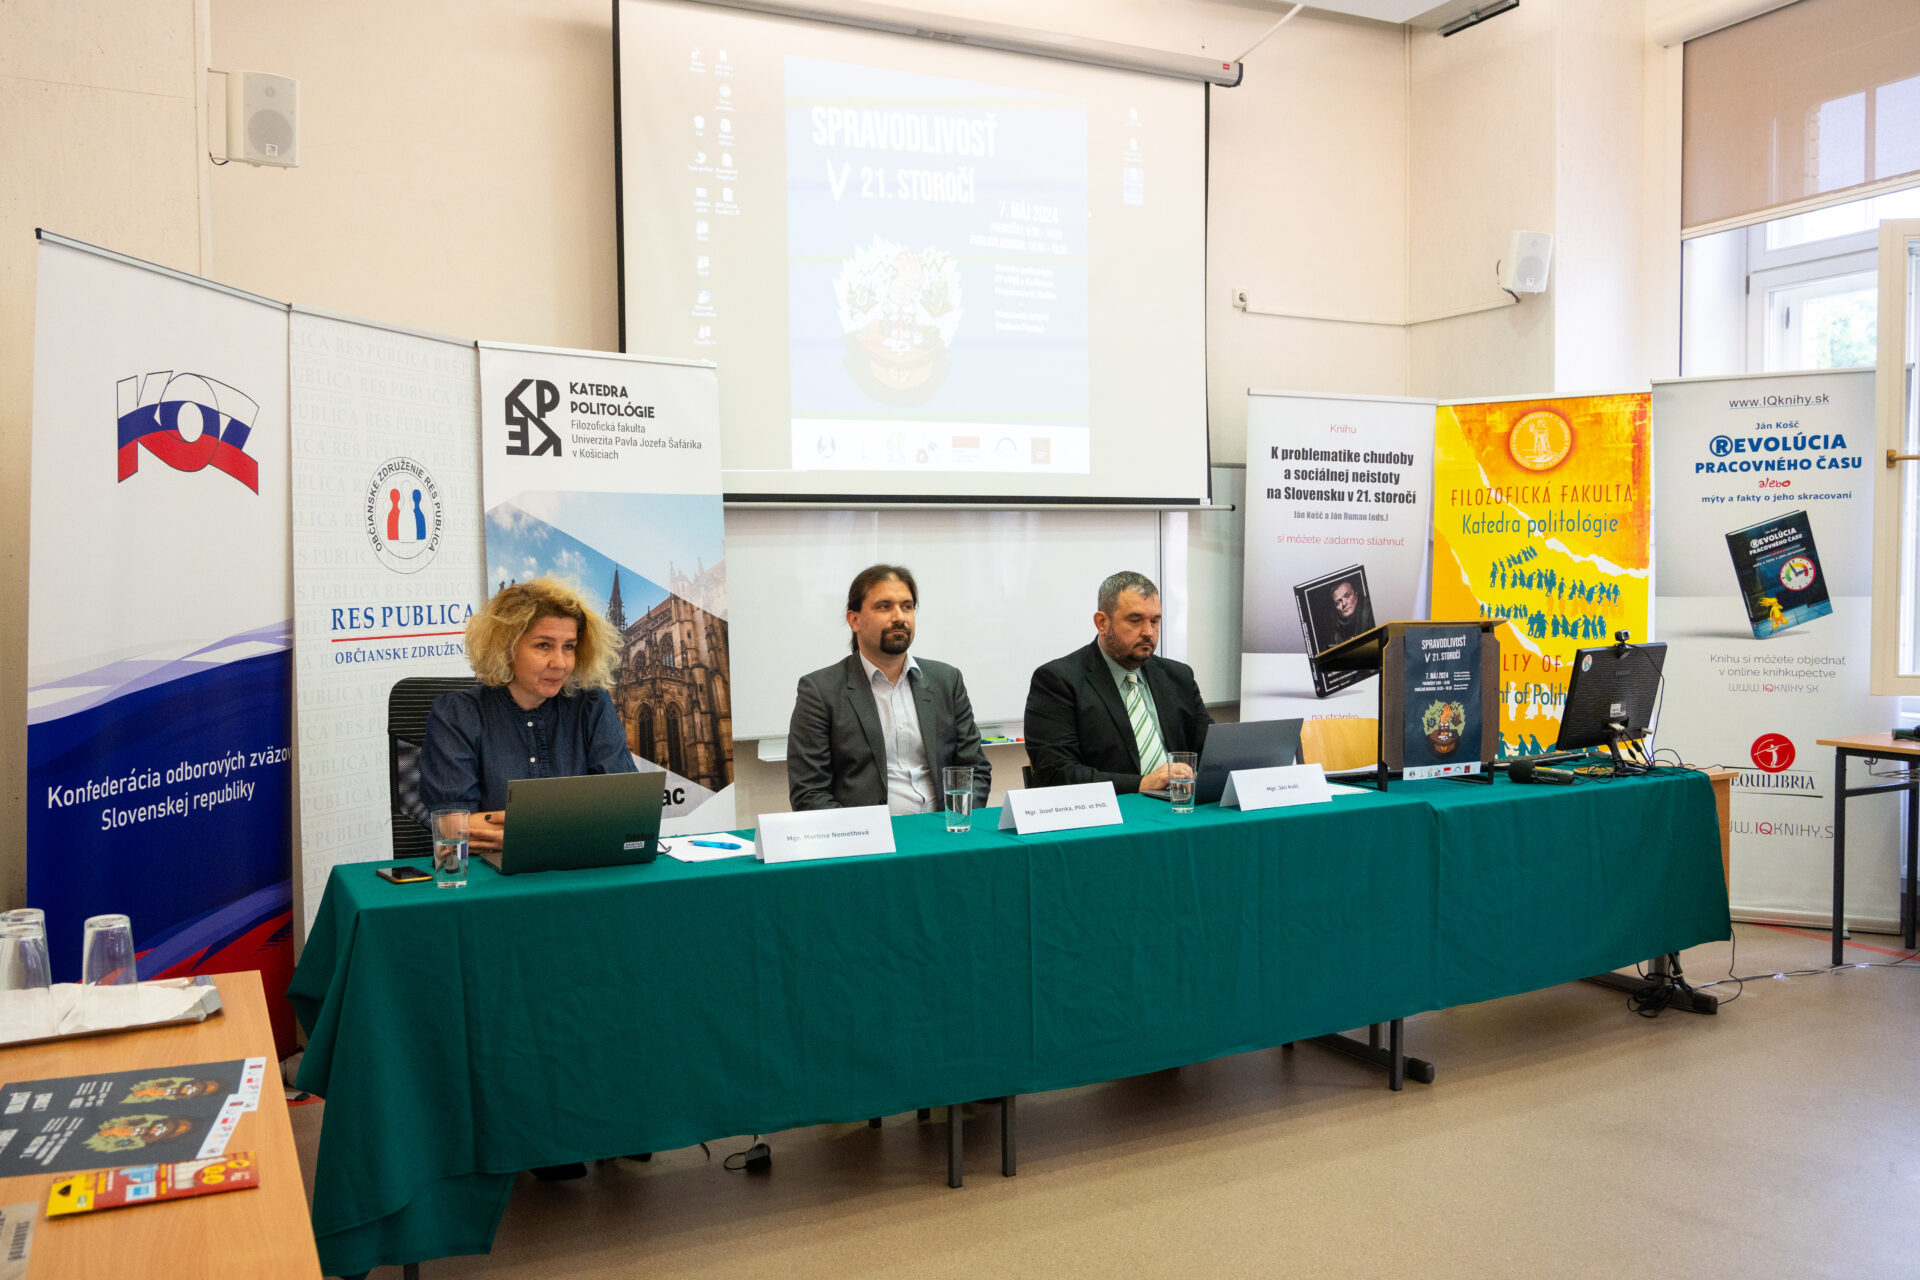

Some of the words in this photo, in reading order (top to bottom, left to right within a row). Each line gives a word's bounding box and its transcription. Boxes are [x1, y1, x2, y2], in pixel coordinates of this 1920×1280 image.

[811, 105, 1000, 158] SPRAVODLIVOSŤ
[826, 160, 850, 202] V
[860, 166, 893, 200] 21.
[897, 166, 976, 204] STOROČÍ
[569, 382, 629, 398] KATEDRA
[1729, 393, 1830, 408] www.IQknihy.sk
[570, 401, 656, 419] POLITOLÓGIE
[571, 420, 616, 432] Filozofická
[617, 423, 646, 433] fakulta
[1330, 424, 1357, 434] Knihu
[1755, 421, 1773, 430] Ján
[1775, 420, 1800, 430] Košč
[572, 434, 613, 446] Univerzita
[615, 436, 638, 447] Pavla
[639, 437, 667, 448] Jozefa
[668, 437, 702, 449] Šafárika
[579, 449, 619, 460] Košiciach
[1271, 446, 1279, 459] K
[1281, 448, 1361, 463] problematike
[1363, 451, 1414, 466] chudoby
[377, 459, 425, 482] ZDRUŽENIE
[1695, 457, 1813, 474] PRACOVNÉHO
[1816, 455, 1862, 471] ČASU
[1284, 469, 1291, 480] a
[1294, 467, 1349, 483] sociálnej
[1352, 471, 1400, 485] neistoty
[1758, 478, 1792, 489] alebo
[424, 476, 438, 500] RES
[1267, 488, 1281, 500] na
[1284, 487, 1345, 501] Slovensku
[1347, 492, 1354, 502] v
[1356, 490, 1371, 503] 21.
[1374, 490, 1417, 504] storočí
[1451, 481, 1551, 507] FILOZOFICKÁ
[1561, 484, 1633, 504] FAKULTA
[1702, 494, 1726, 504] mýty
[1736, 493, 1761, 503] fakty
[1772, 492, 1794, 503] jeho
[1797, 491, 1852, 501] skracovaní
[367, 480, 384, 552] OBČIANSKE
[1294, 510, 1305, 519] Ján
[1306, 510, 1323, 520] Košč
[1330, 511, 1342, 520] Ján
[1343, 512, 1367, 521] Ruman
[1462, 511, 1520, 535] Katedra
[1527, 509, 1619, 538] politológie
[428, 502, 442, 552] PUBLICA
[1277, 535, 1285, 543] si
[1286, 534, 1321, 545] môžete
[1324, 535, 1364, 546] zadarmo
[331, 607, 375, 631] RES
[381, 603, 474, 628] PUBLICA
[1421, 634, 1467, 650] SPRAVODLIVOSŤ
[335, 647, 409, 665] OBČIANSKE
[1424, 653, 1431, 663] V
[1432, 652, 1441, 662] 21.
[1441, 649, 1461, 661] STOROČÍ
[1542, 654, 1562, 673] OF
[1710, 654, 1740, 664] Knihu
[1743, 655, 1751, 664] si
[1753, 654, 1794, 665] môžete
[1797, 655, 1847, 667] objednať
[1727, 667, 1761, 677] online
[1763, 667, 1837, 678] knihkupectve
[1514, 682, 1530, 705] of
[1728, 683, 1819, 694] WWW.IQKNIHY.SK
[47, 768, 161, 809] Konfederácia
[166, 750, 246, 785] odborových
[249, 746, 293, 768] zväzov
[101, 792, 189, 830] Slovenskej
[193, 780, 256, 811] republiky
